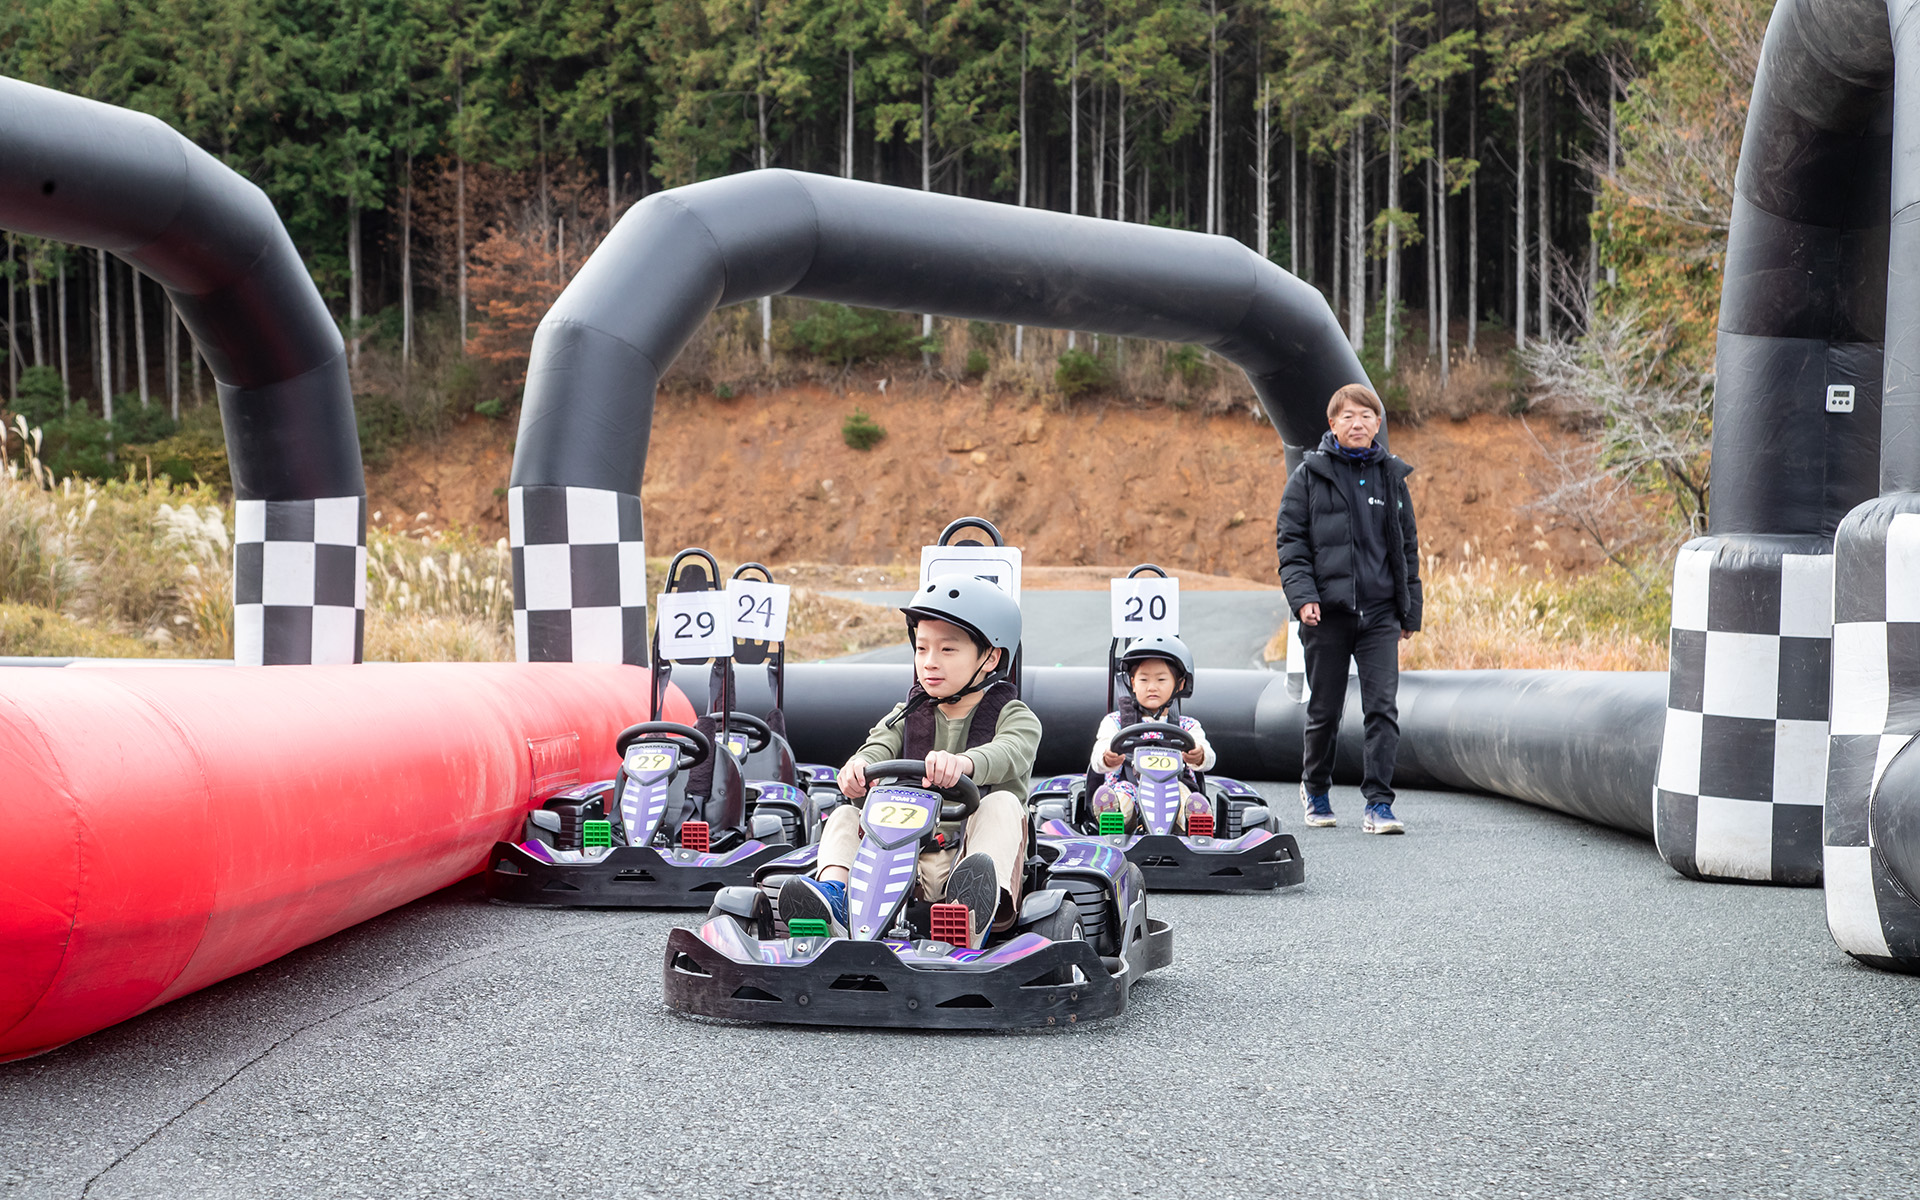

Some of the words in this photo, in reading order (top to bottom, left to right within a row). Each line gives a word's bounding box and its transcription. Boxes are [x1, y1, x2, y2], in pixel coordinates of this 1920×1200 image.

[737, 594, 776, 629] 24
[1125, 595, 1167, 622] 20
[674, 611, 716, 639] 29
[637, 755, 665, 768] 29
[1147, 756, 1171, 769] 20
[880, 805, 918, 825] 27
